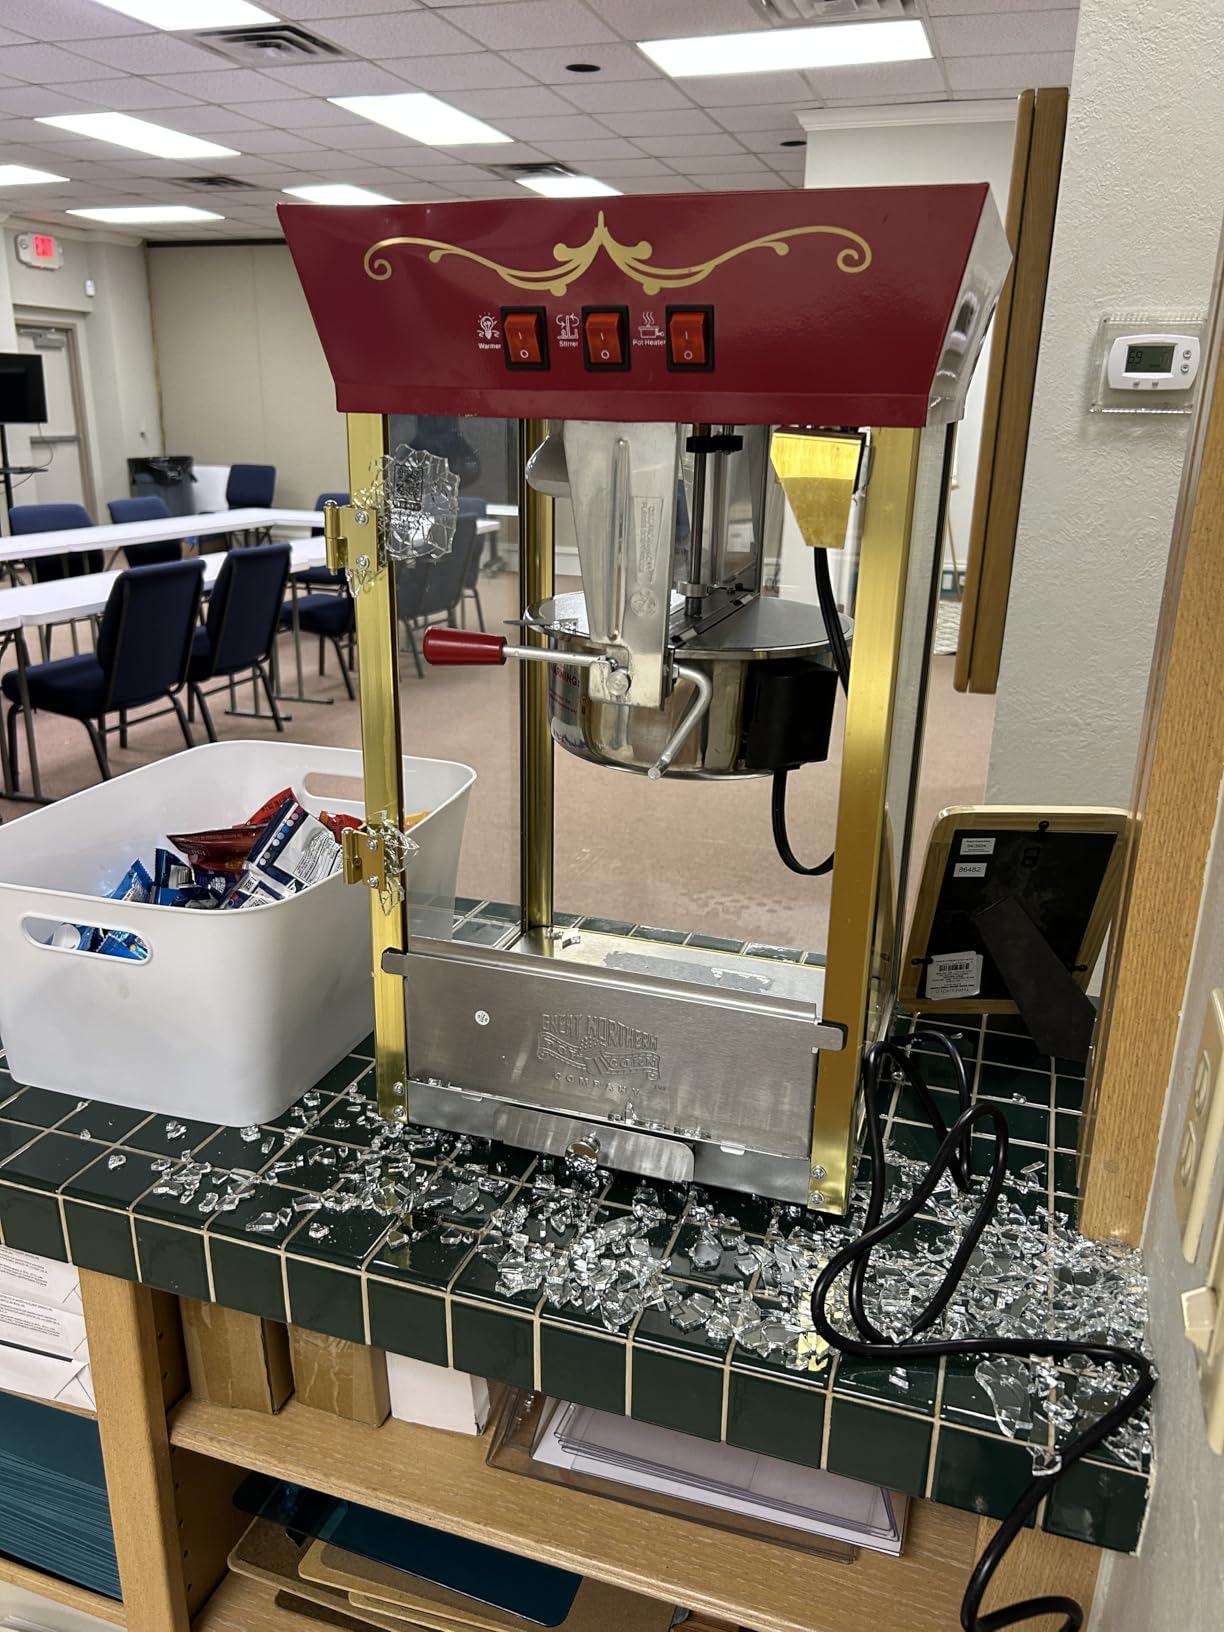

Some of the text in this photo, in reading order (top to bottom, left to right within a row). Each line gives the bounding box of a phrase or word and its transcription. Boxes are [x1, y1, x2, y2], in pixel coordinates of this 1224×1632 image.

[559, 340, 579, 348] Stirrer
[586, 1014, 659, 1051] NORTHERN
[553, 1071, 641, 1097] COMPANY
